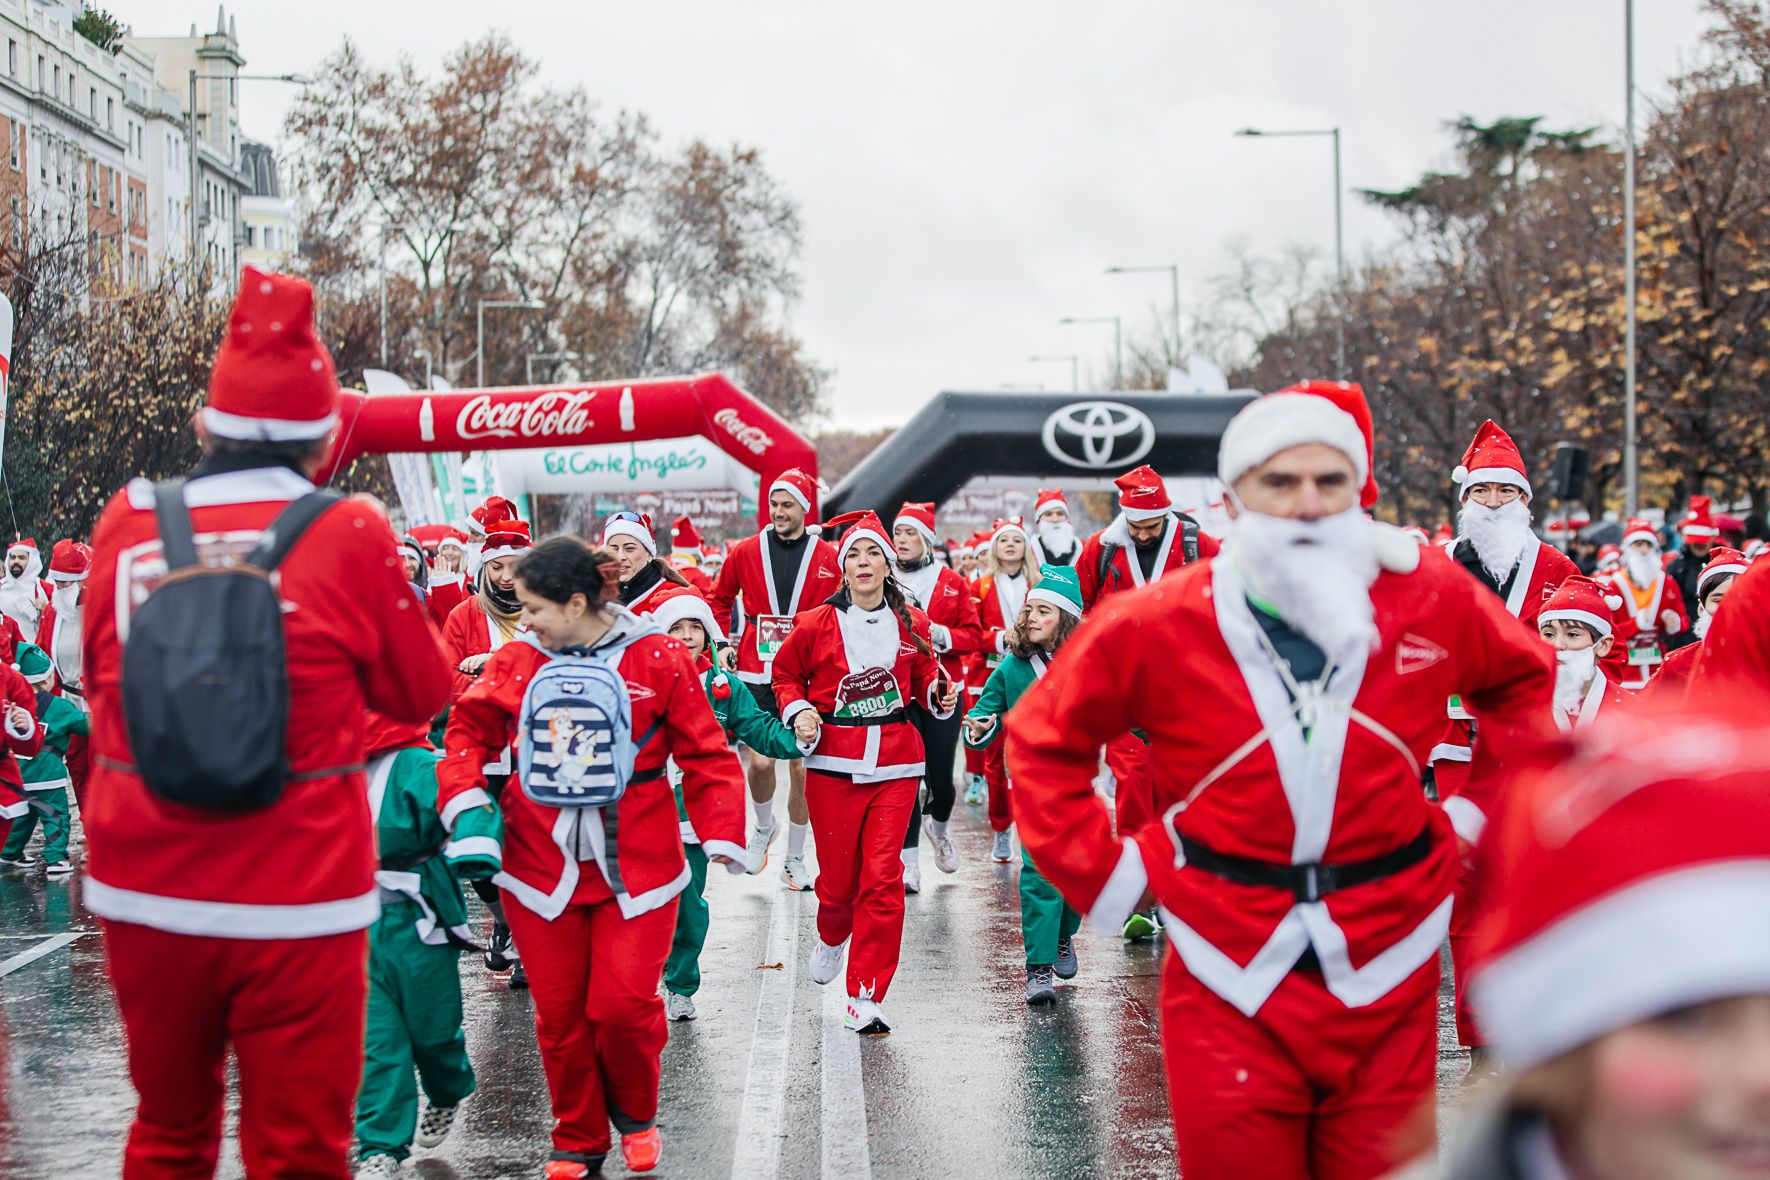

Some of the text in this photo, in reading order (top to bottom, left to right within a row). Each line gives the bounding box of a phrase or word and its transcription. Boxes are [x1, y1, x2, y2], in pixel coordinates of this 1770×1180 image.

[456, 390, 597, 439] Coca-Cola
[544, 442, 706, 479] El Corte Inglés
[849, 678, 870, 689] Papá
[848, 695, 887, 717] 8800
